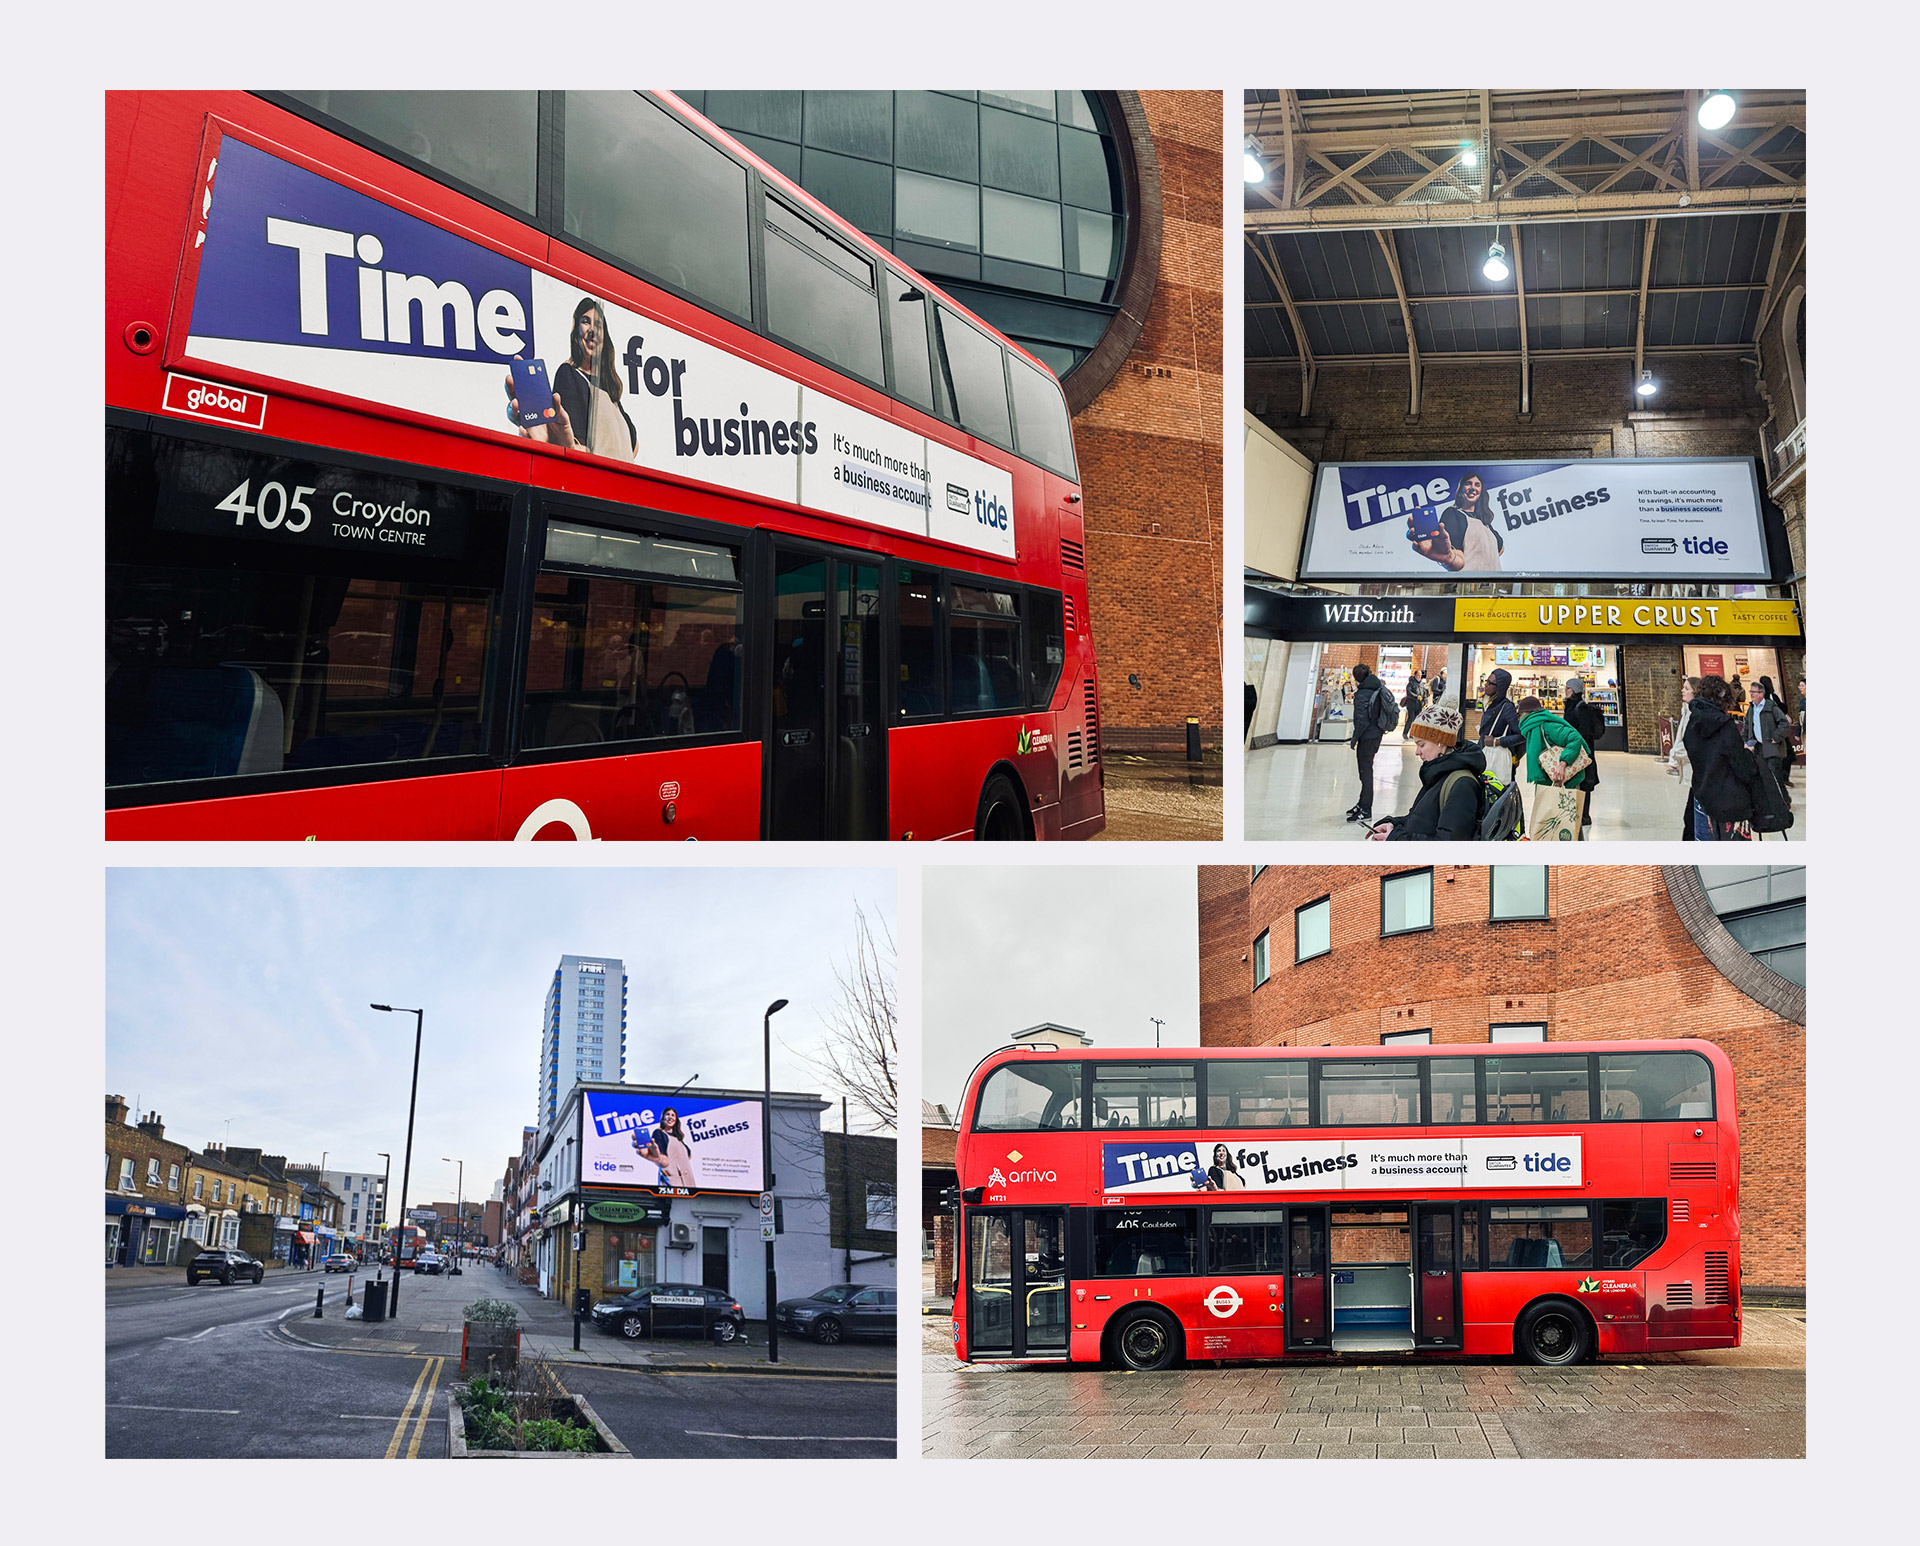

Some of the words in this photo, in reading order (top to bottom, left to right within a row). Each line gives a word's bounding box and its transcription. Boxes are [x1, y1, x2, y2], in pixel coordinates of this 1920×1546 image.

[267, 217, 527, 356] Time
[622, 335, 686, 397] for
[187, 385, 248, 414] global
[673, 398, 819, 458] business
[833, 432, 851, 456] It's
[852, 444, 882, 467] much
[884, 456, 909, 476] more
[909, 461, 932, 484] than
[833, 466, 841, 481] a
[843, 464, 891, 496] business
[892, 484, 932, 509] account
[214, 477, 317, 533] 405
[332, 491, 431, 527] Croydon
[975, 489, 1008, 531] tide
[1346, 477, 1451, 525] Time
[1496, 487, 1533, 511] for
[1503, 487, 1611, 532] business
[332, 523, 375, 541] TOWN
[378, 529, 427, 546] CENTRE
[1682, 536, 1729, 555] tide
[1324, 604, 1415, 623] WHSmith
[1538, 604, 1622, 626] UPPER
[1633, 605, 1719, 628] CRUST
[595, 1109, 655, 1134] Time
[686, 1117, 707, 1132] for
[690, 1119, 750, 1143] business
[594, 1161, 617, 1171] tide
[1116, 1151, 1197, 1182] Time
[1236, 1148, 1269, 1169] for
[1263, 1153, 1358, 1184] business
[1370, 1154, 1386, 1162] It's
[1387, 1153, 1414, 1162] much
[1444, 1153, 1468, 1161] than
[1523, 1152, 1571, 1172] tide
[1008, 1168, 1057, 1183] arriva
[1379, 1165, 1424, 1175] business
[1426, 1165, 1468, 1174] account
[763, 1199, 771, 1209] 20
